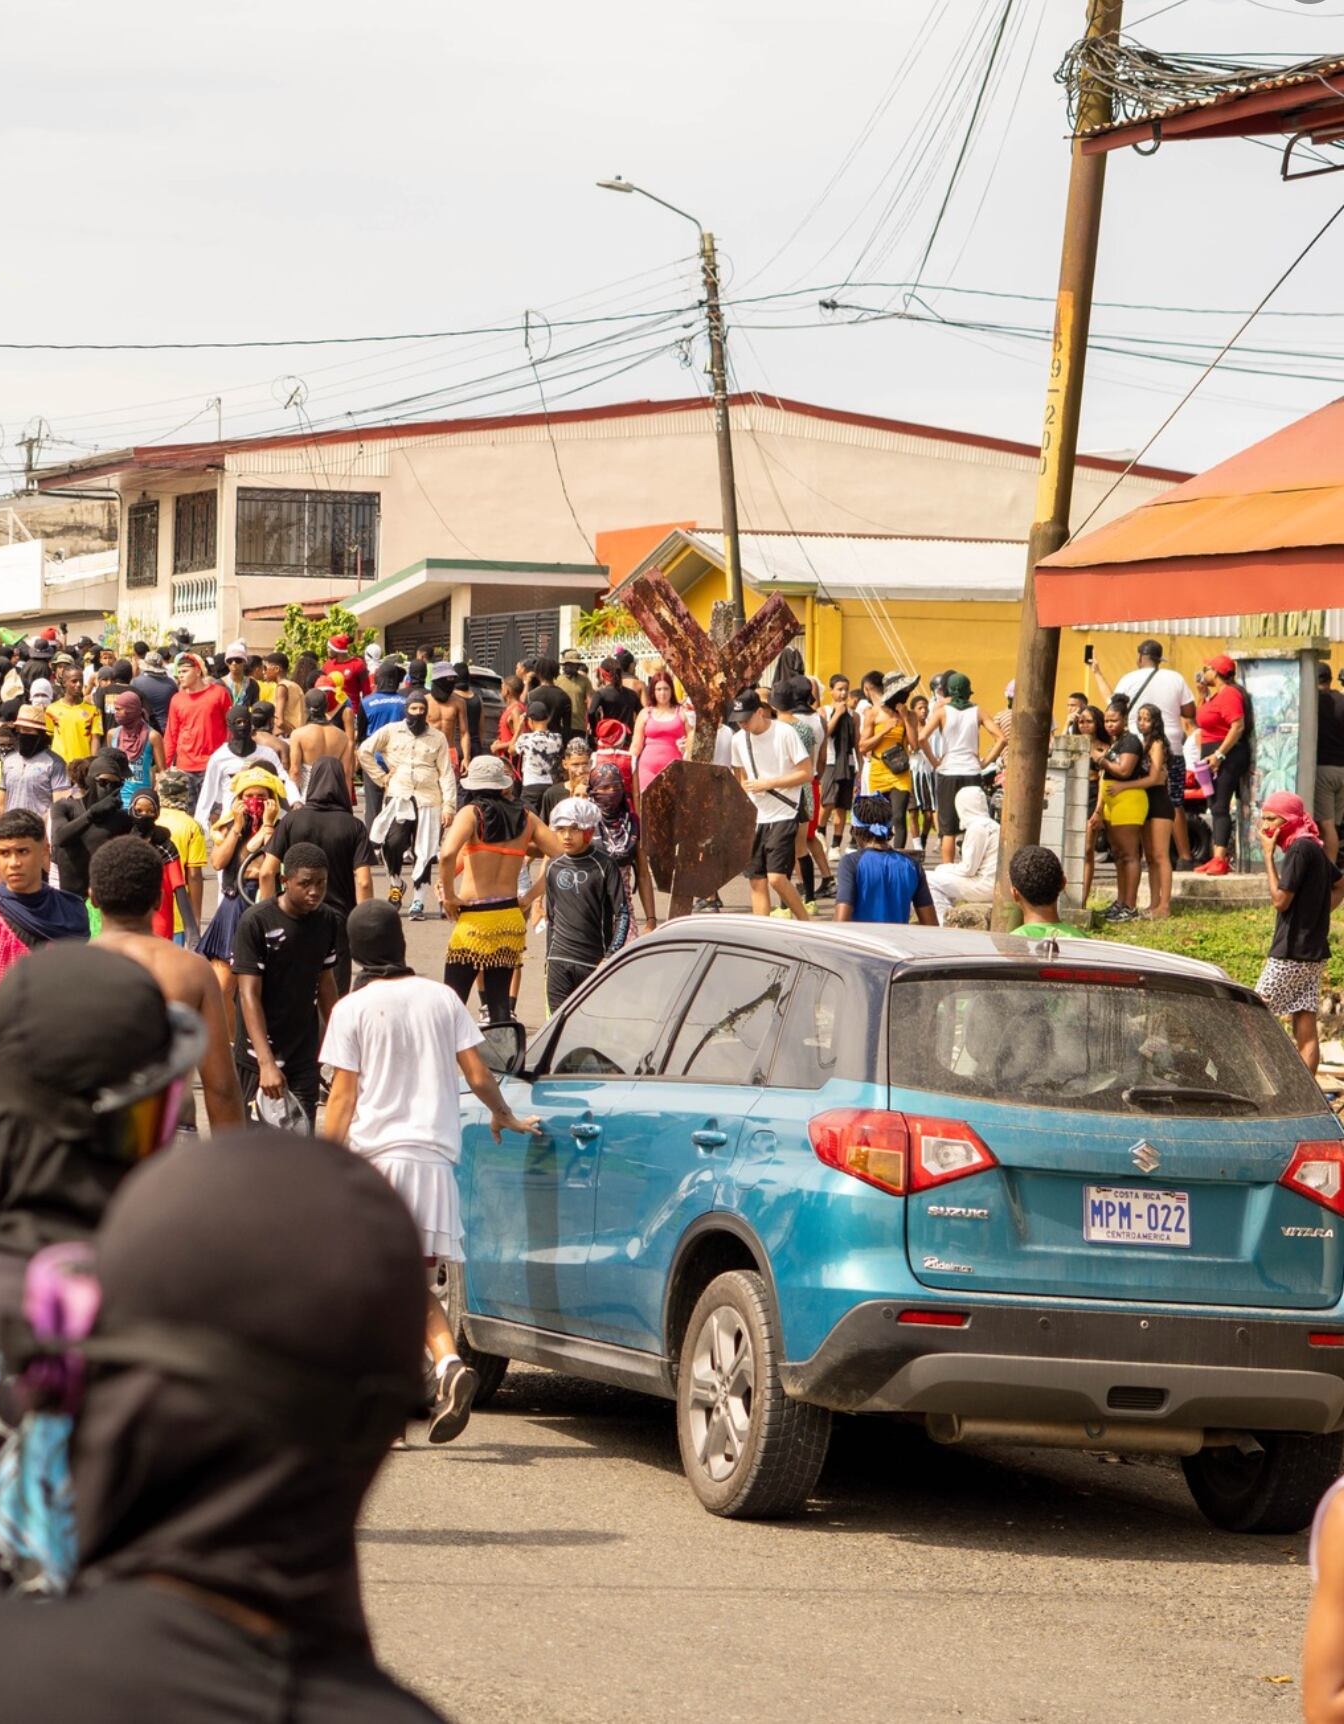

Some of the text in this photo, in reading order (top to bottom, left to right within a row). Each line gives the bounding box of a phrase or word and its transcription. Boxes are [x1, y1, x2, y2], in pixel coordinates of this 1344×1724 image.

[1113, 1190, 1161, 1201] COSTA RICA
[927, 1205, 989, 1220] SUZUKI
[1090, 1199, 1186, 1233] MPM-022
[1105, 1230, 1171, 1241] CENTROAMERICA
[1280, 1226, 1334, 1238] VITARA
